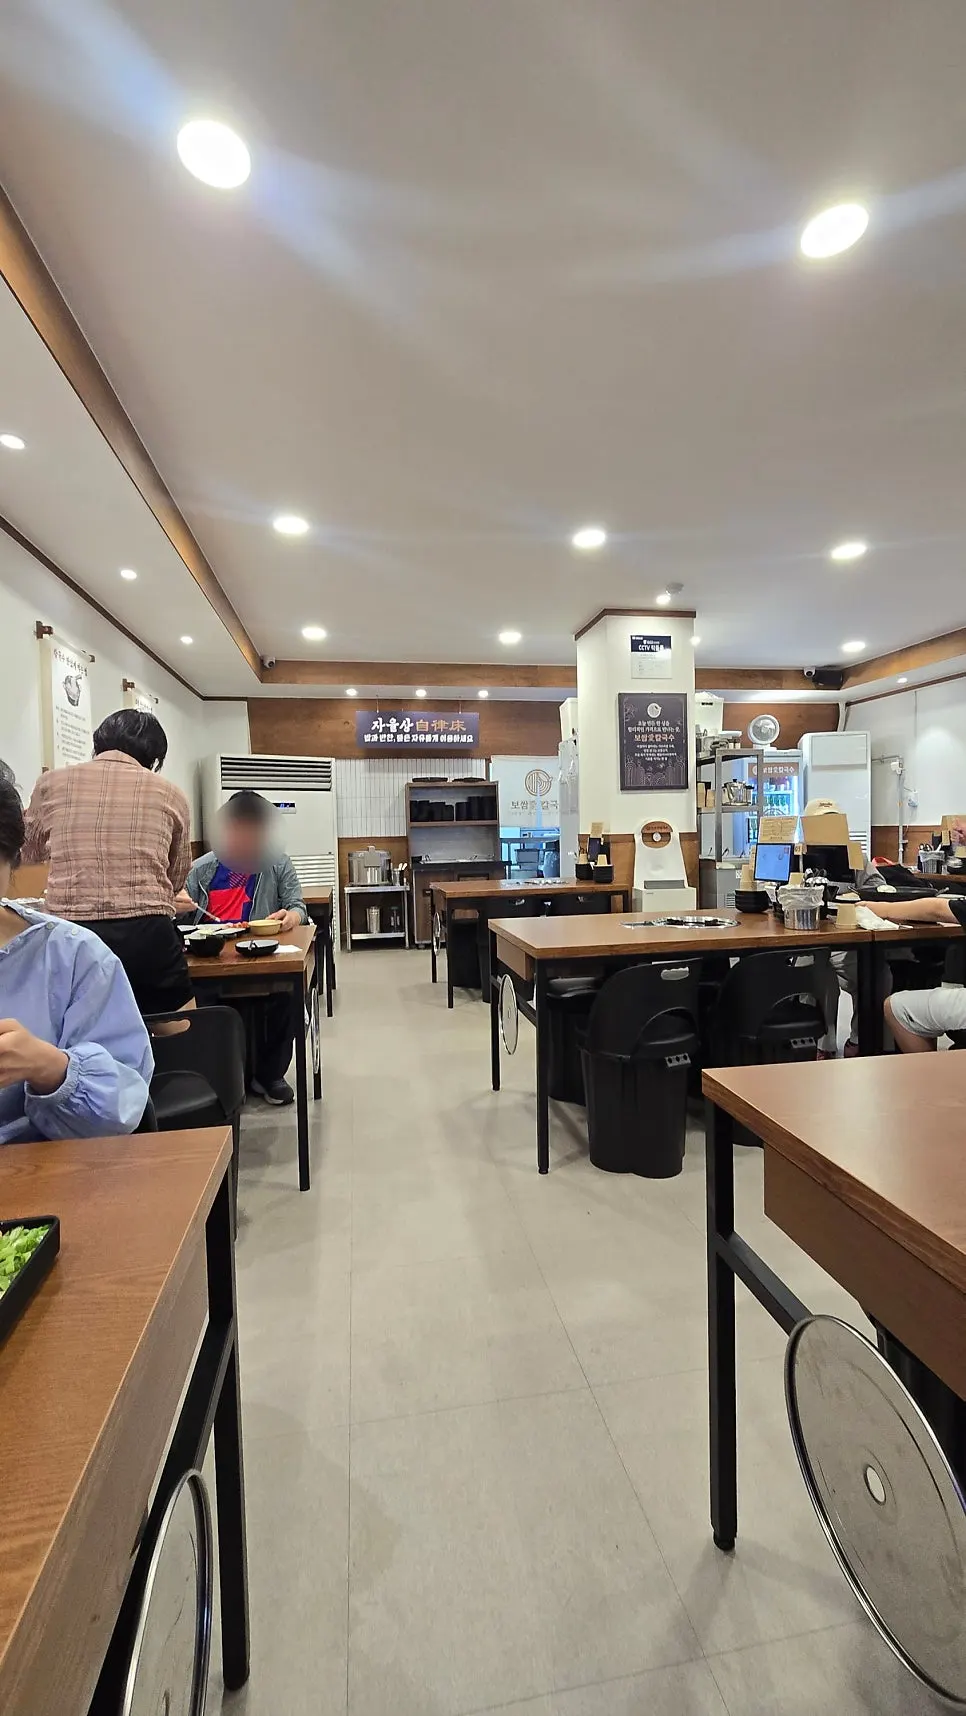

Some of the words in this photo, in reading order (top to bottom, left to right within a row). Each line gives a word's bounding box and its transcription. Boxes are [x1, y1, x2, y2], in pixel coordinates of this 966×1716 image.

[371, 717, 414, 733] 자율상
[364, 733, 378, 743] 밥과
[411, 734, 439, 743] 자유롭게
[439, 734, 474, 743] 이용하세요
